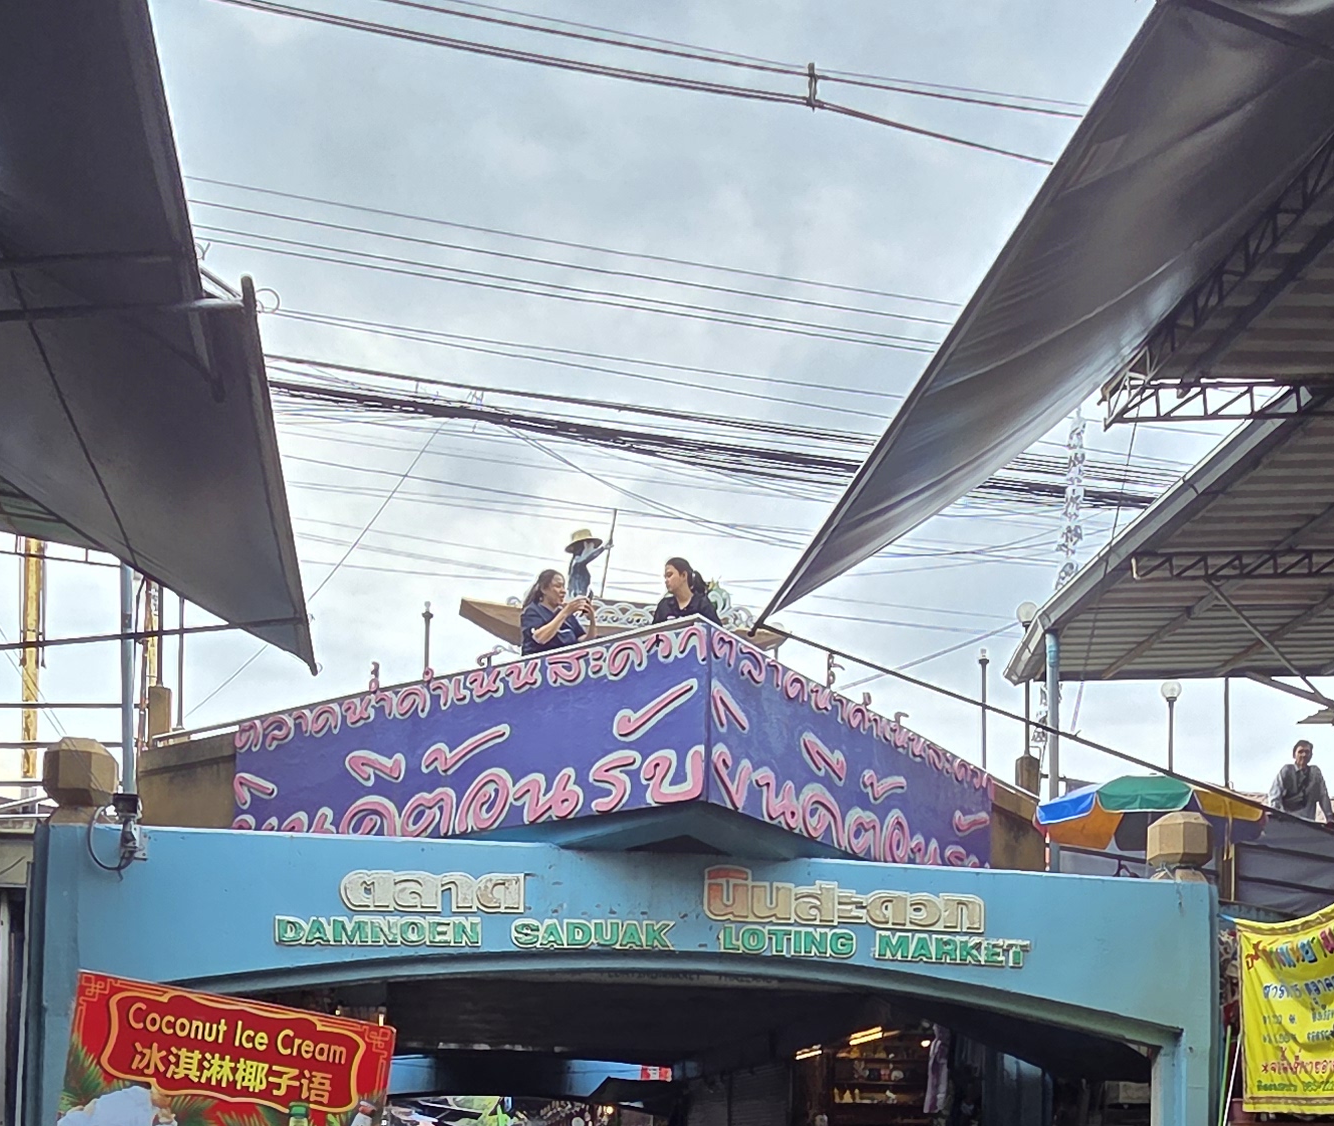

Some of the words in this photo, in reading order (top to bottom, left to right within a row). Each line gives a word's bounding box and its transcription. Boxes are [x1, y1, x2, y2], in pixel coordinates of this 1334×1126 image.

[340, 869, 527, 914] ตลาด
[274, 915, 482, 947] DAMNOEN
[510, 918, 677, 950] SADUAK
[720, 924, 857, 958] LOTING
[872, 929, 1032, 969] MARKET
[128, 1002, 226, 1044] Coconut
[234, 1020, 269, 1050] Ice
[276, 1029, 347, 1065] Cream
[131, 1042, 333, 1104] 冰淇淋椰子语
